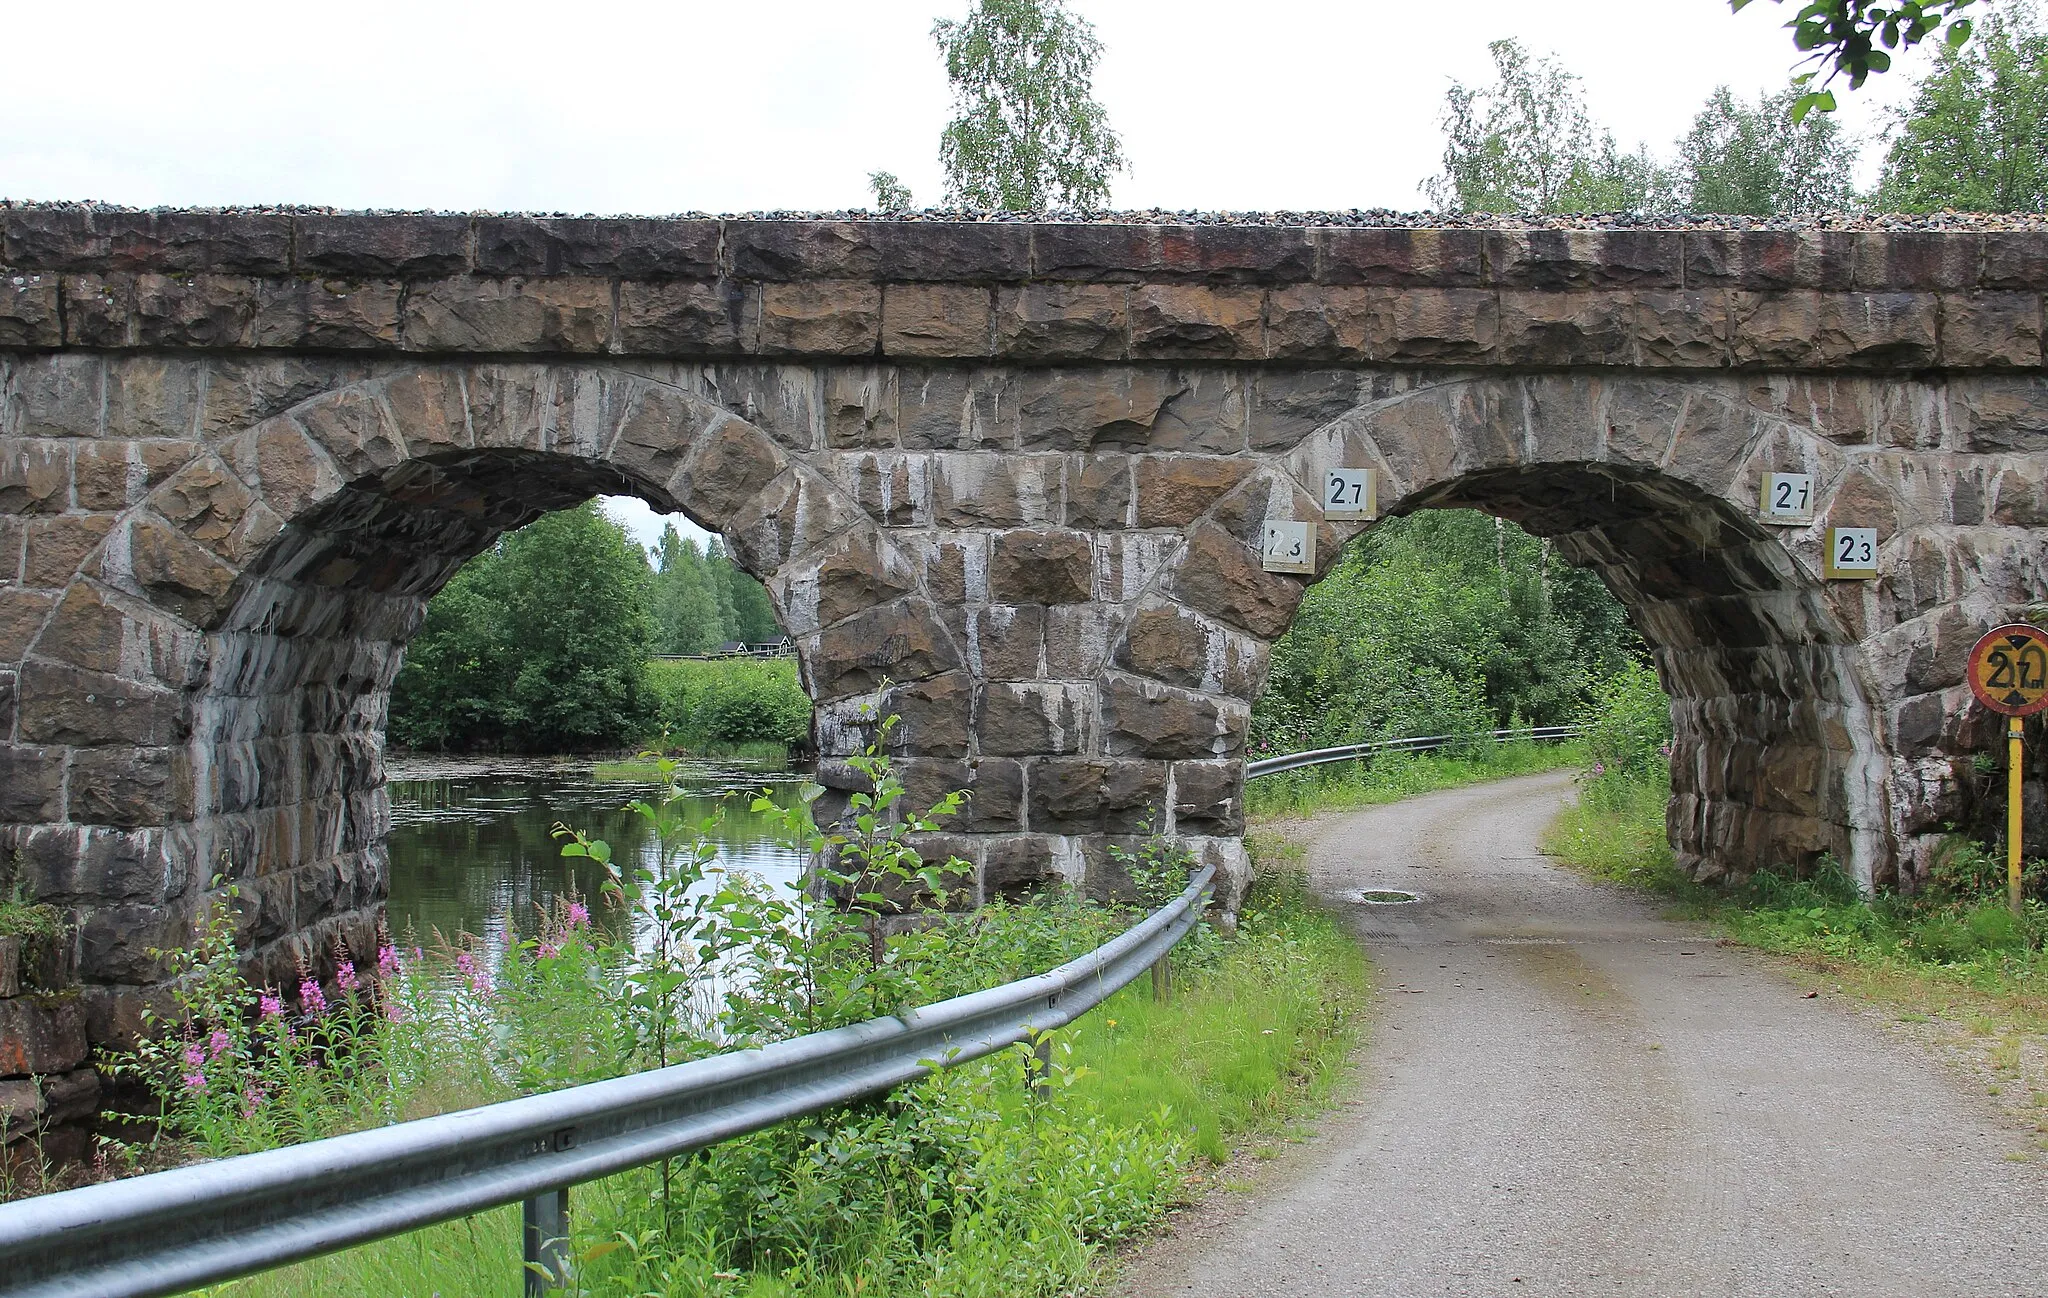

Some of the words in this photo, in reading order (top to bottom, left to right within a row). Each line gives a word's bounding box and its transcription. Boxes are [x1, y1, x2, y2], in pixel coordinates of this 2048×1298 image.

[1330, 477, 1362, 504] 2.7
[1776, 482, 1809, 509] 2.7
[1840, 535, 1871, 562] 2.3
